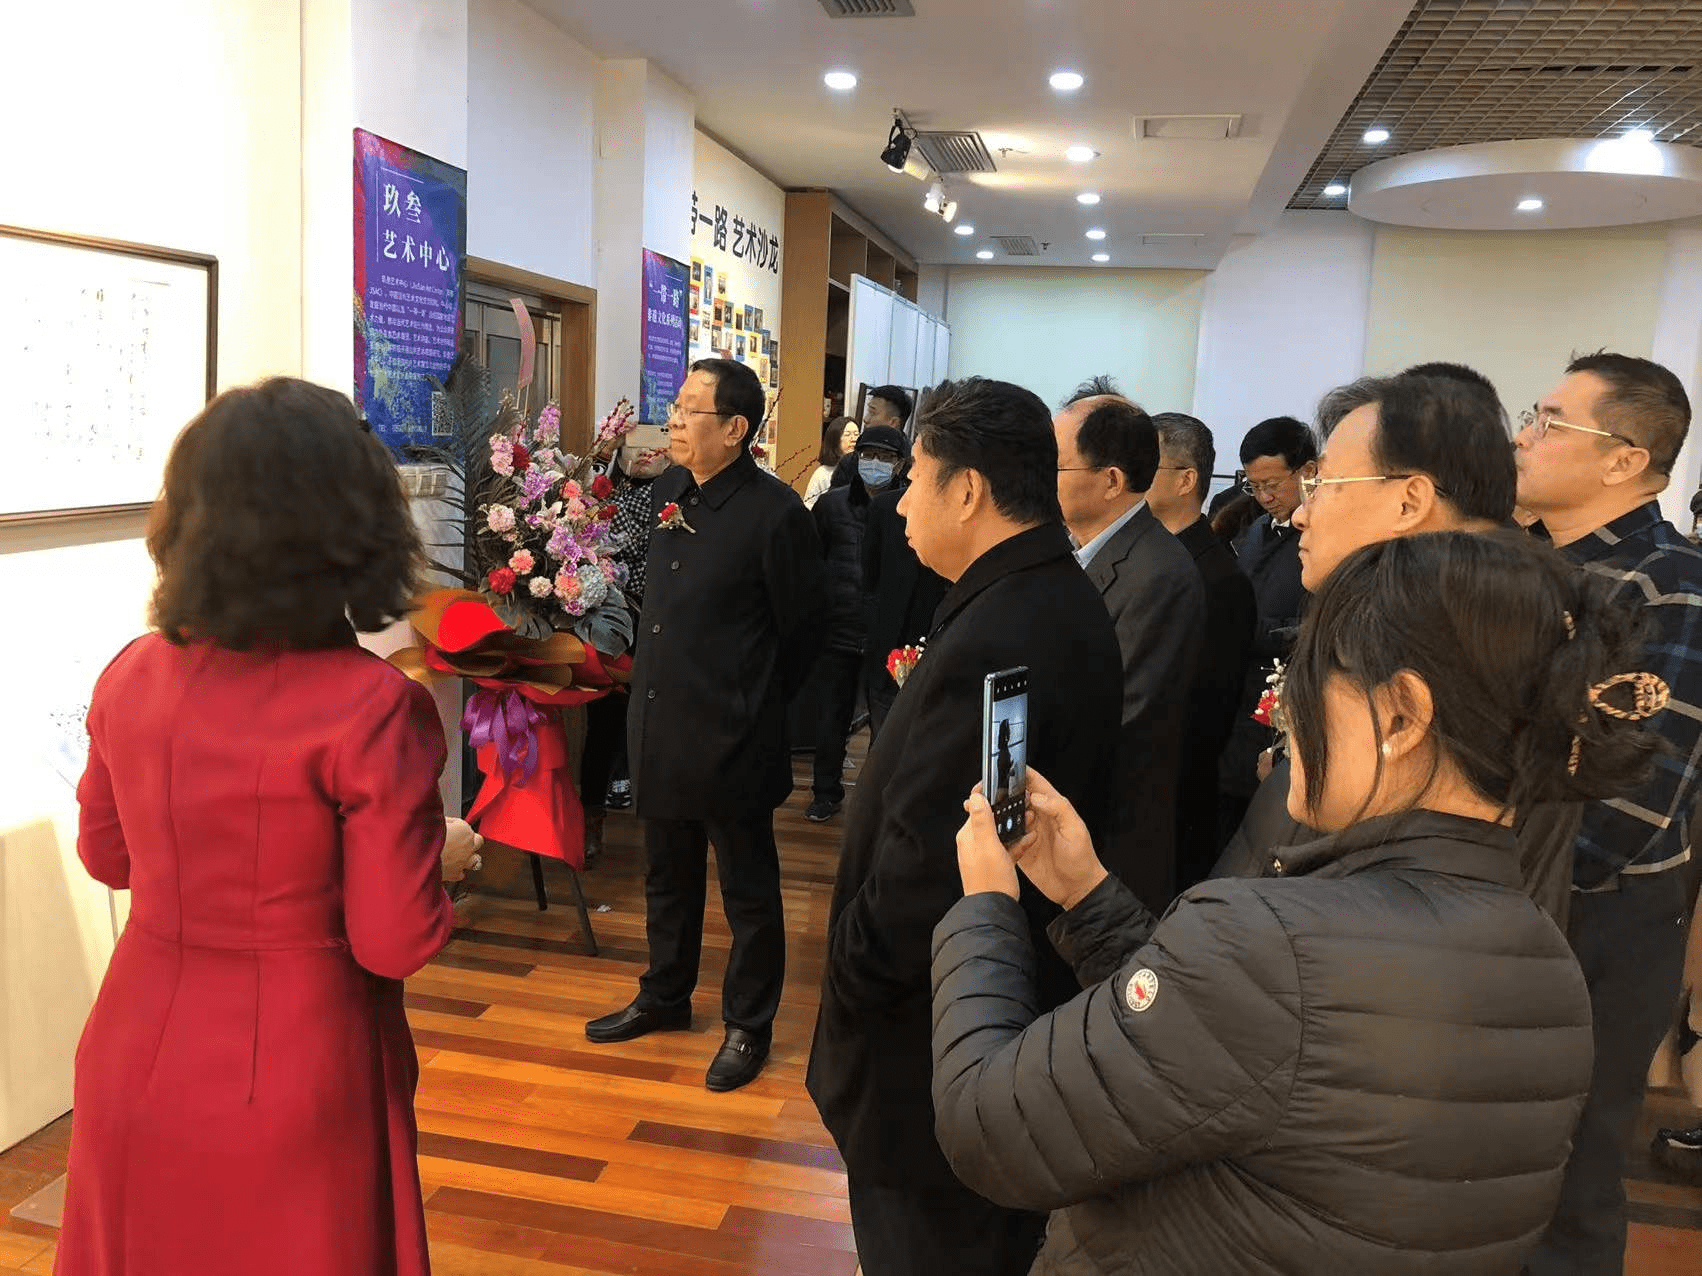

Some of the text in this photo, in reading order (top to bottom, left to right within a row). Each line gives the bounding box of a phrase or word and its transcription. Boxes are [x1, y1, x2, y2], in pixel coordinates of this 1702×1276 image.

[383, 183, 422, 224] 玖叁
[382, 229, 450, 272] 艺术中心
[732, 214, 779, 275] 艺术沙龙
